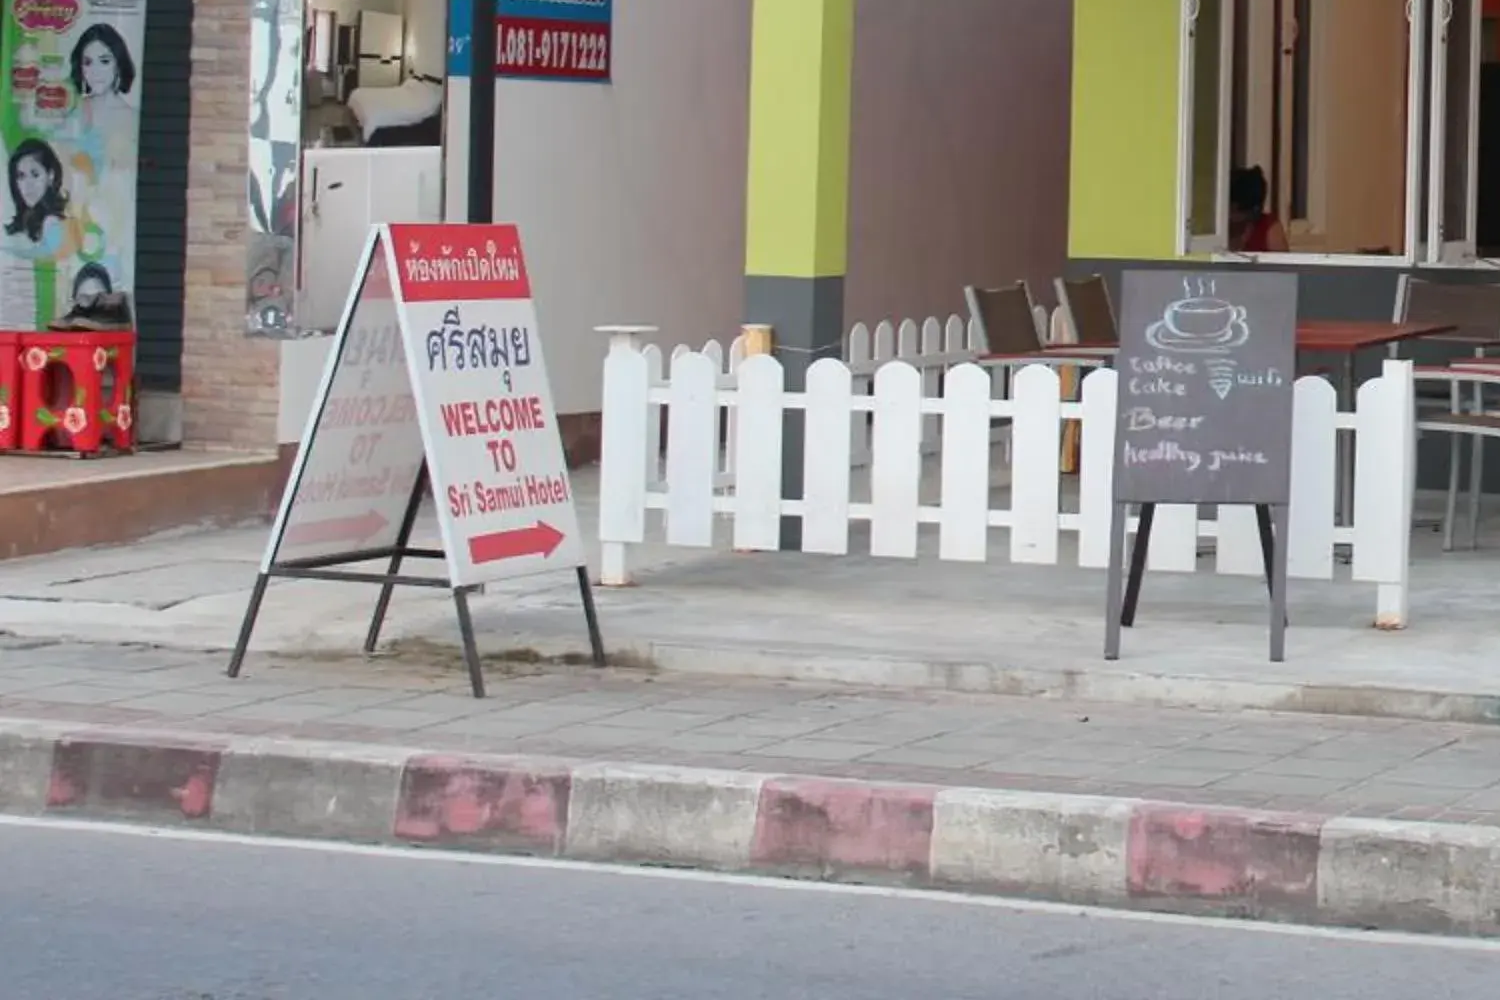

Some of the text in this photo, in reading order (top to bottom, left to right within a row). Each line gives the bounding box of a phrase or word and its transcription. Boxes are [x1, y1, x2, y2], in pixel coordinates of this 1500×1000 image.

[497, 23, 607, 71] l.081-9171222
[404, 238, 519, 282] ห้องพักเปิดใหม่
[427, 305, 531, 393] ศรีสมุย
[440, 396, 545, 437] WELCOME
[1122, 406, 1205, 432] Beer
[487, 439, 517, 473] TO
[1123, 440, 1270, 473] healthy juice
[447, 483, 473, 518] Sri
[474, 476, 525, 513] Samui
[525, 471, 569, 506] Hotel
